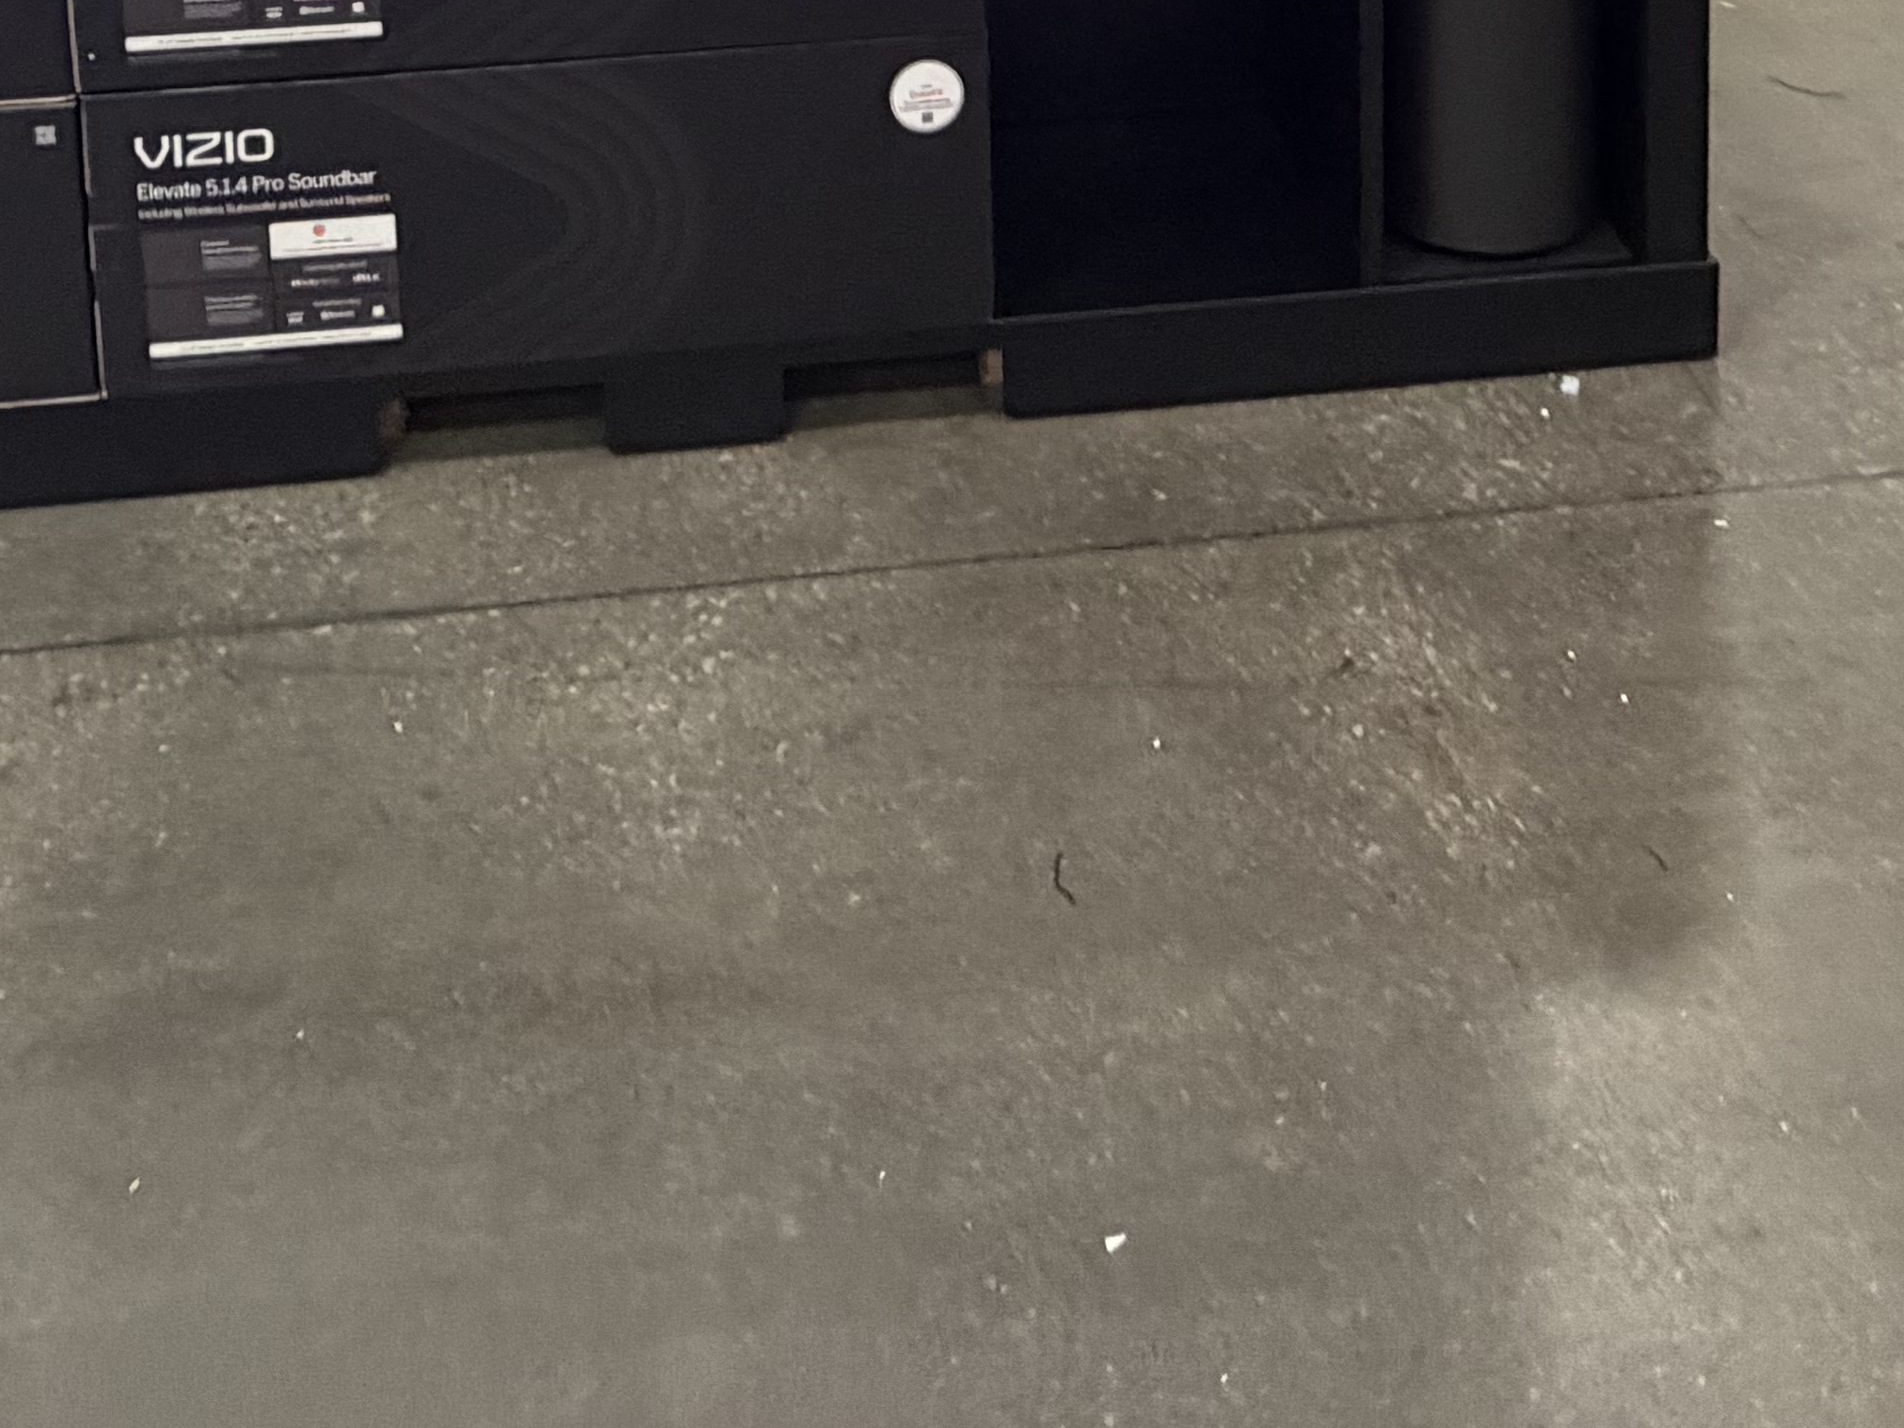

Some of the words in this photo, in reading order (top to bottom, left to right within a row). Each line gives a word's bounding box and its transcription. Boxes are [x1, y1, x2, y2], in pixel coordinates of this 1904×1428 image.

[134, 128, 274, 169] VIZIO
[136, 181, 202, 202] Elevate
[205, 176, 248, 196] 5.1.4
[252, 174, 284, 193] Pro
[288, 169, 377, 190] Soundbar
